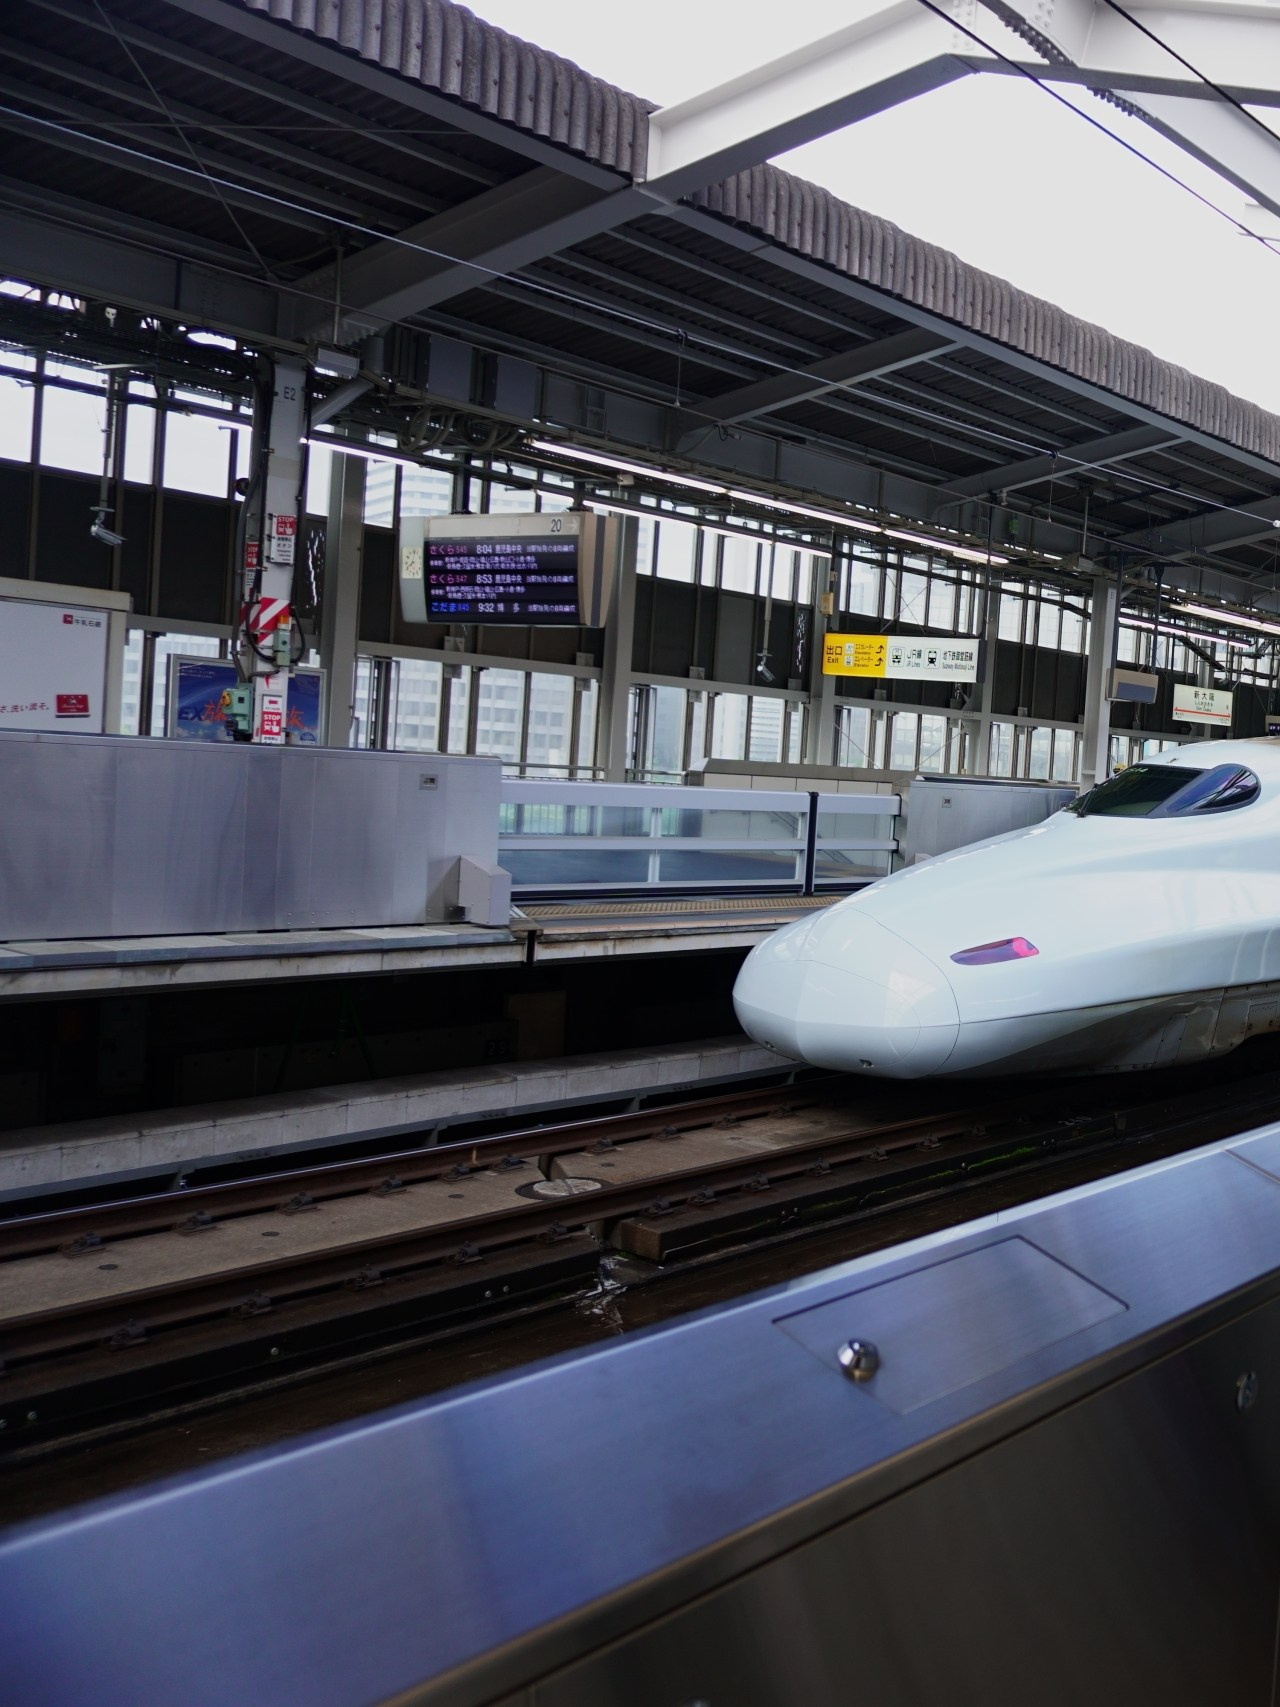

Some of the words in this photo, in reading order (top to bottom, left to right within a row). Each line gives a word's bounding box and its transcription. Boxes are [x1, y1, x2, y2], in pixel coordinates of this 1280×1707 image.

[284, 386, 296, 401] E2
[551, 519, 562, 533] 20
[476, 544, 492, 554] 8:04
[476, 574, 492, 584] 8:53
[478, 602, 495, 613] 9:32
[826, 645, 843, 655] 出口
[827, 656, 839, 664] Exit
[1194, 690, 1215, 702] 新大阪
